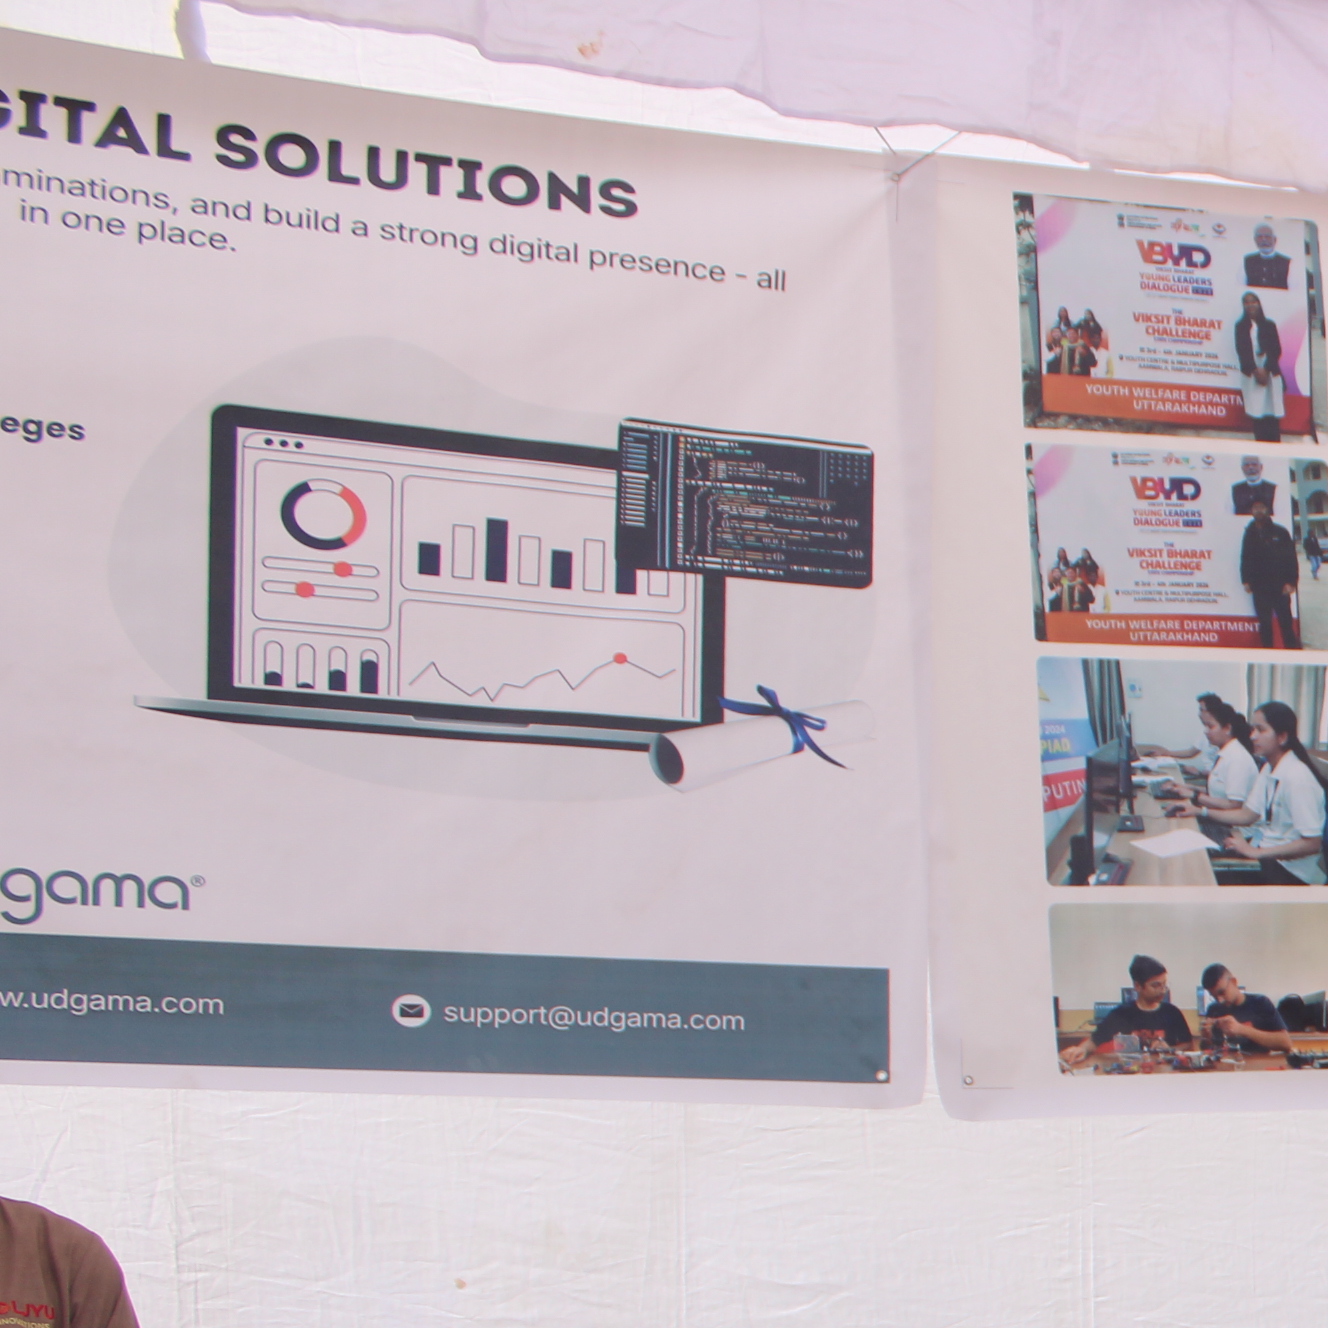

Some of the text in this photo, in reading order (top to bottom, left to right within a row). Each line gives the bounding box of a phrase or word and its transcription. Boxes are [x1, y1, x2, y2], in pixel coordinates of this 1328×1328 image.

[0, 90, 639, 219] ITAL SOLUTIONS
[2, 168, 179, 216] minations,
[191, 197, 252, 222] and
[263, 201, 341, 234] build
[351, 219, 369, 238] a
[380, 221, 478, 255] strong
[488, 232, 579, 265] digital
[588, 246, 726, 284] presence
[756, 269, 787, 293] all
[20, 199, 237, 253] in one place.
[1139, 271, 1213, 286] YOUNG LEADERS
[1140, 280, 1191, 294] DIALOGUE
[1132, 311, 1223, 330] VIKSIT BHARAT
[1145, 324, 1212, 341] CHALLENGE
[1085, 383, 1130, 397] YOUTH
[1131, 386, 1187, 402] WELFARE
[1133, 399, 1226, 417] UTTARAKHAND
[0, 416, 86, 443] eges
[1132, 507, 1202, 518] YOUNG LEADERS
[1133, 516, 1181, 528] DIALOGUE
[1127, 547, 1213, 560] VIKSIT BHARAT
[1139, 559, 1203, 571] CHALLENGE
[1085, 618, 1261, 632] YOUTH WELFARE DEPARTMENT
[1129, 630, 1219, 643] UTTARAKHAND
[443, 1005, 746, 1033] support@udgama.com
